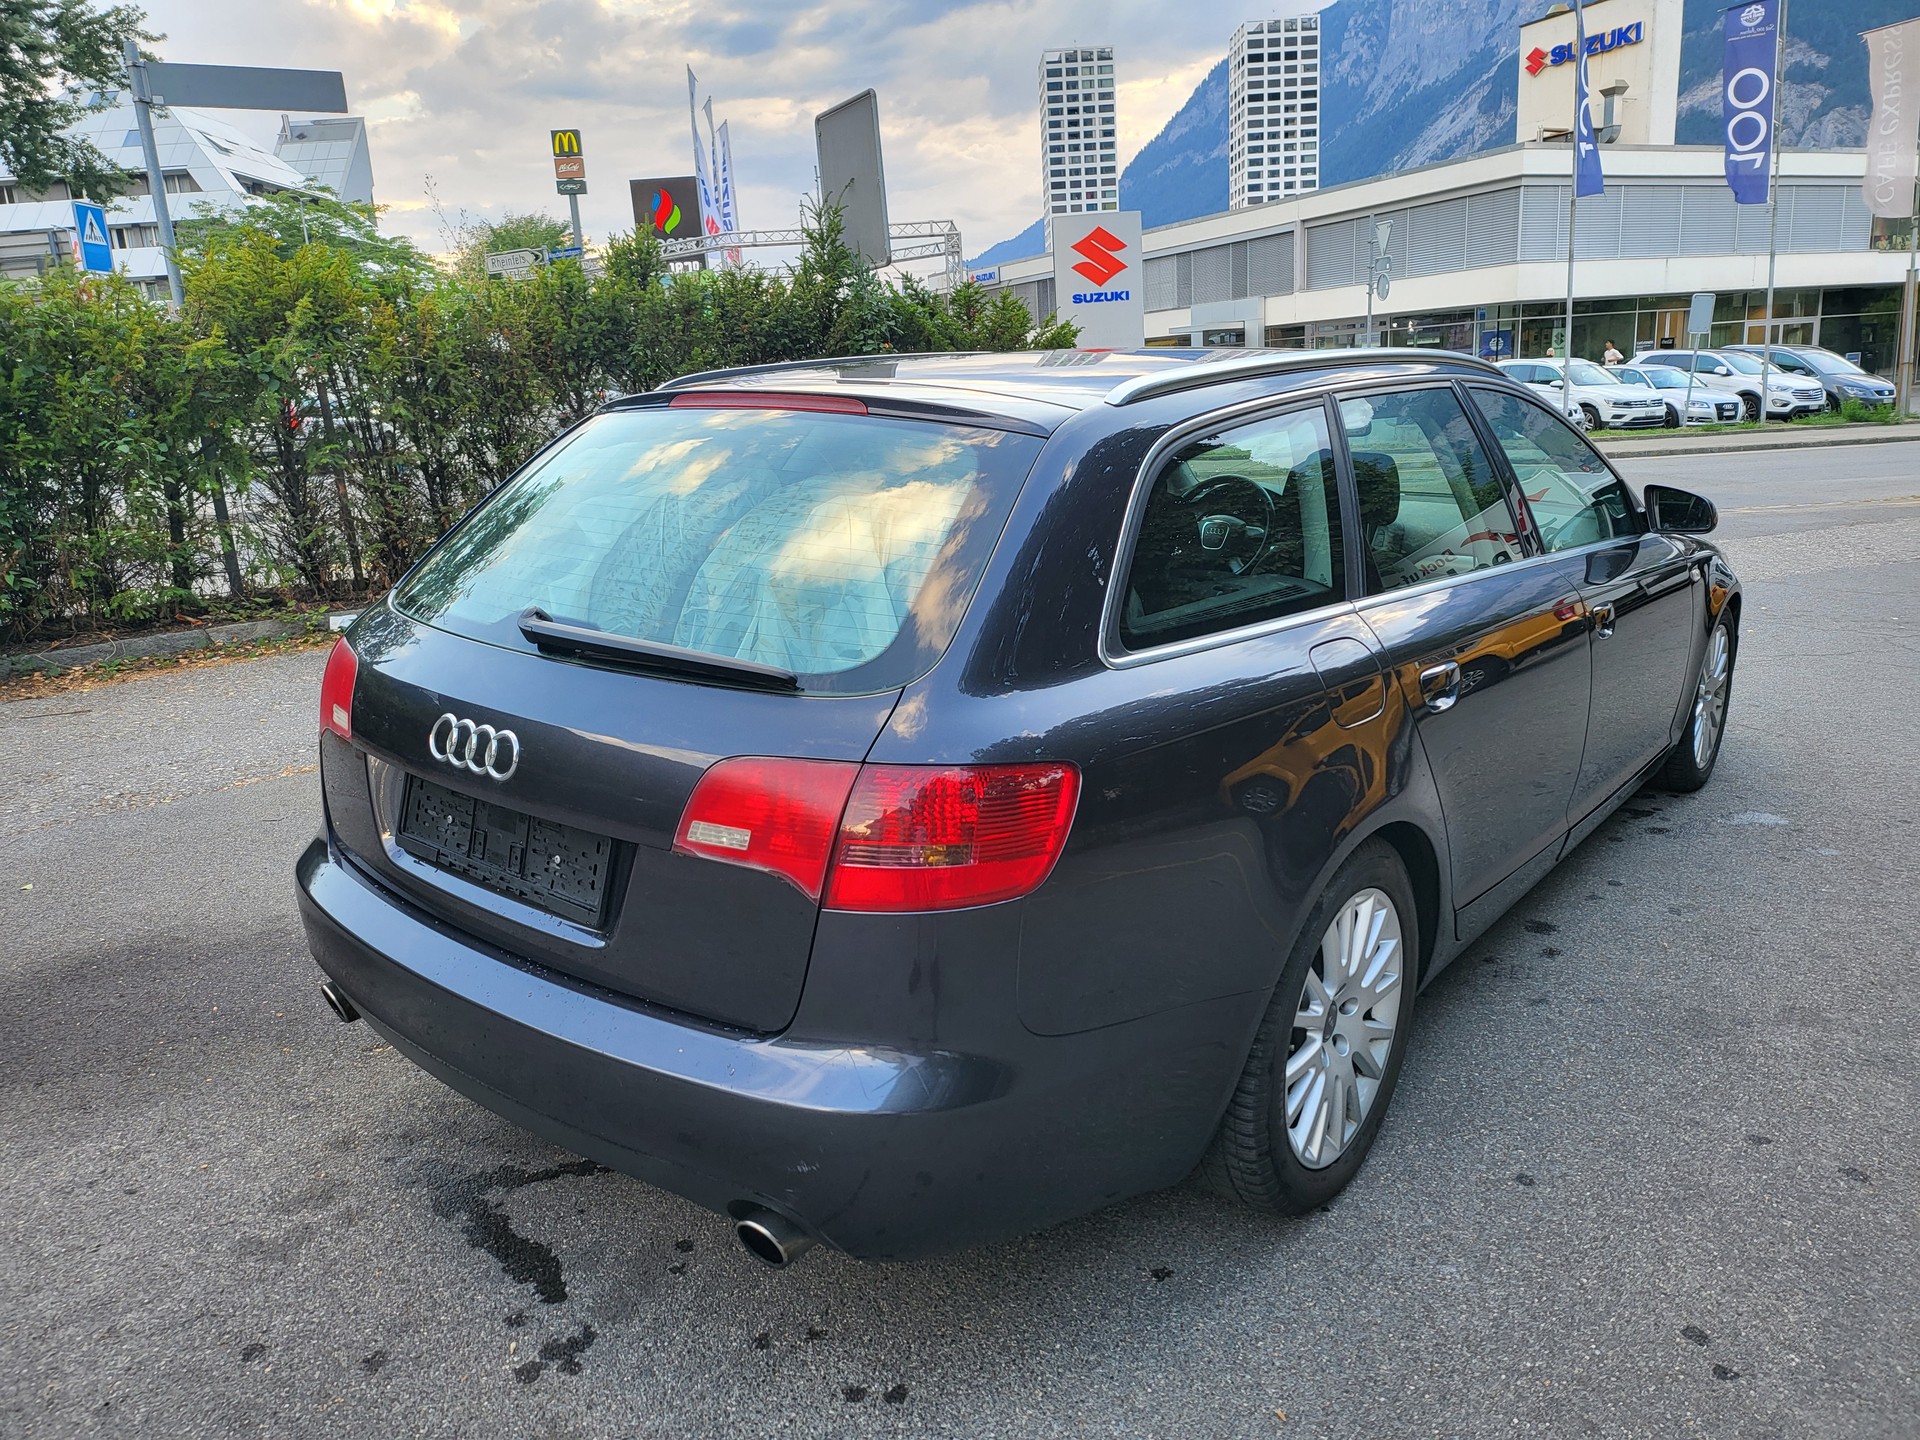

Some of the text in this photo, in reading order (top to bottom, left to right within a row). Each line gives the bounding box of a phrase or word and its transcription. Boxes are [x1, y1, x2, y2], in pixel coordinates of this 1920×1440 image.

[1551, 21, 1644, 65] SUZUKI
[491, 254, 527, 270] Rheinfels
[975, 271, 996, 282] SUZUKI
[1072, 290, 1130, 304] SUZUKI
